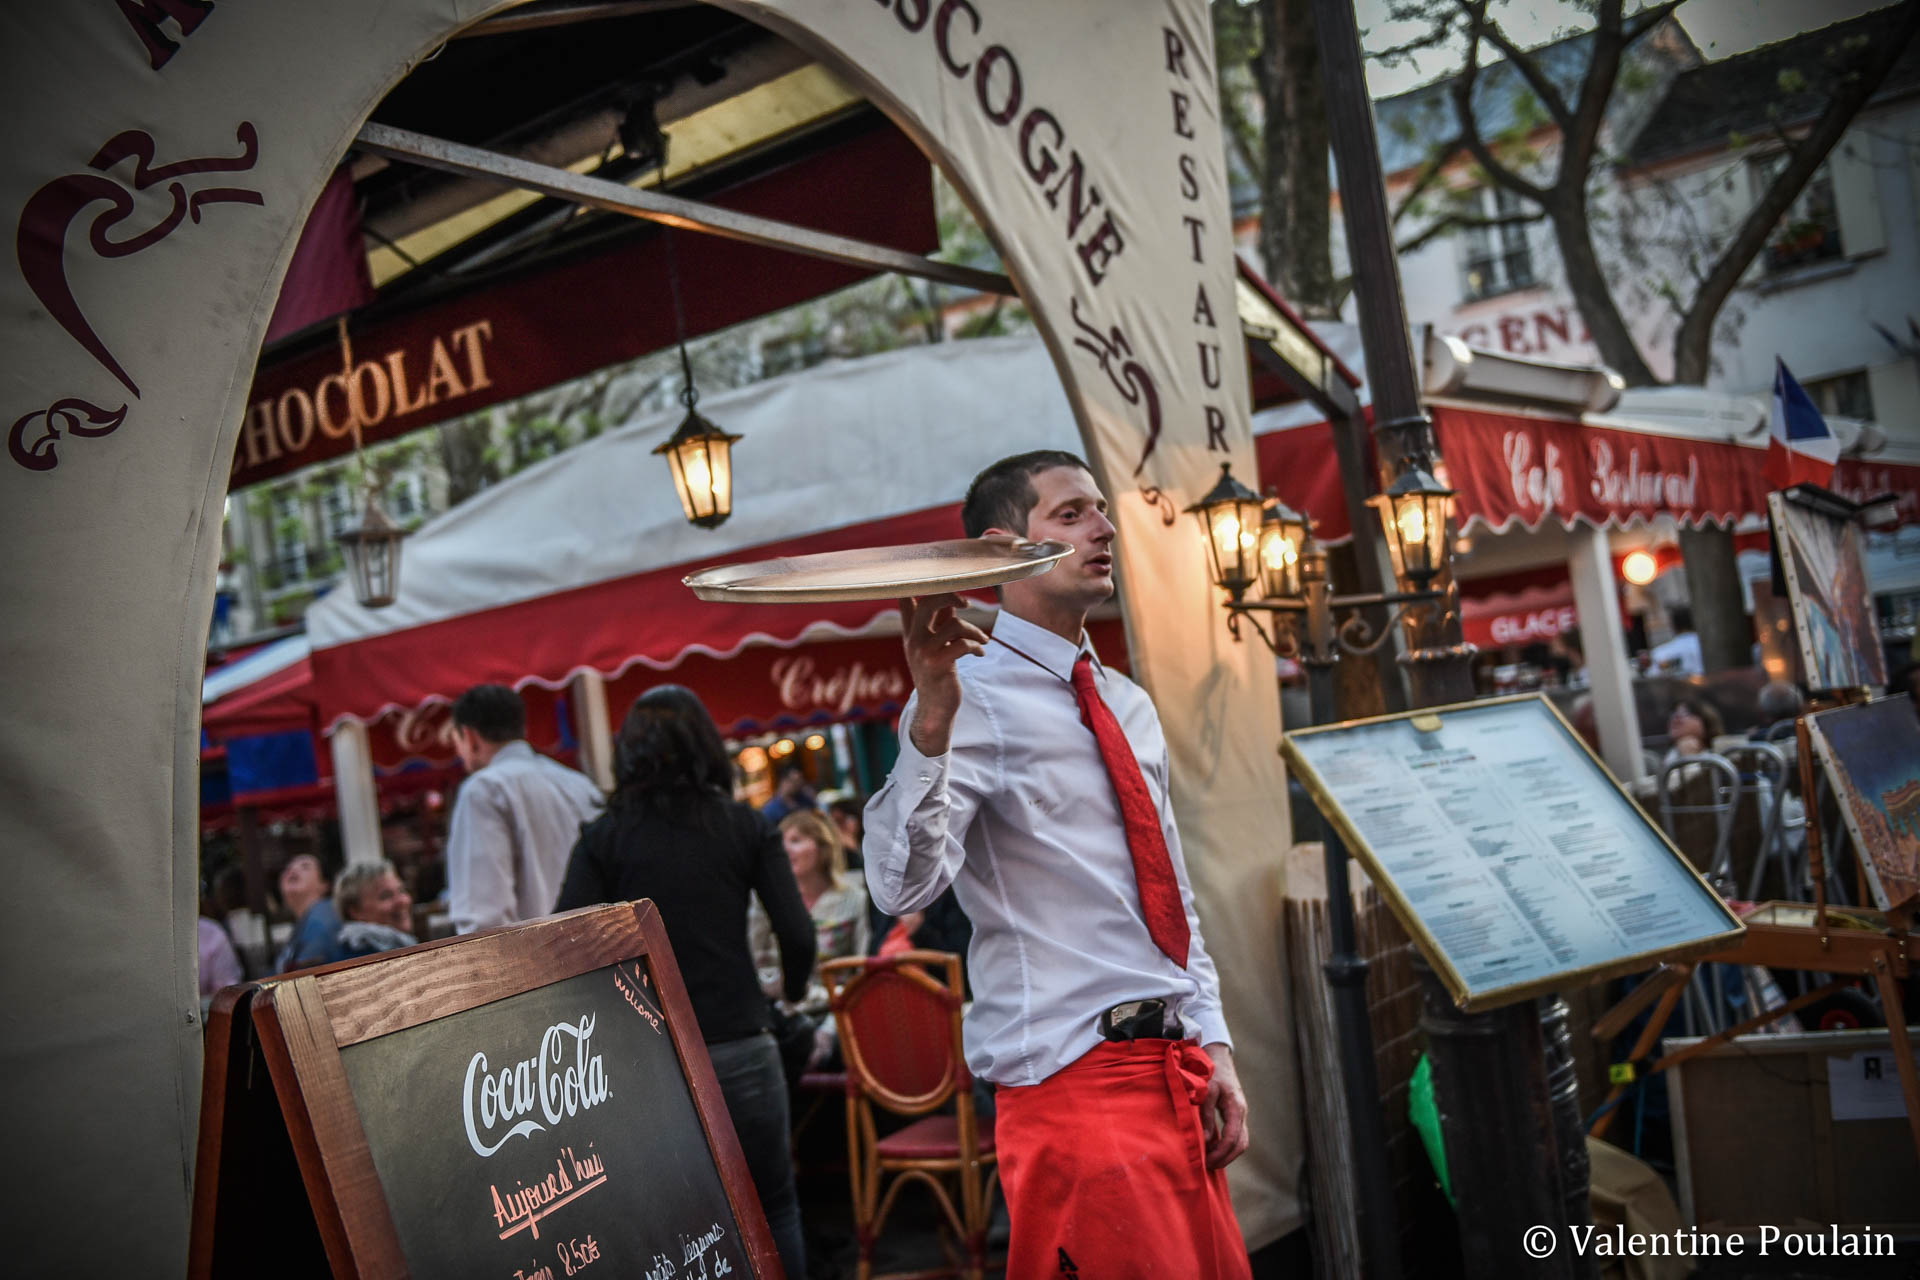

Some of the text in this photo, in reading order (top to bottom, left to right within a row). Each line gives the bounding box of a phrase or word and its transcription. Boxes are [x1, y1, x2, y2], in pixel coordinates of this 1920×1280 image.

[874, 0, 1125, 287] COGNE
[1163, 26, 1231, 454] RESTAUR
[233, 320, 493, 475] HOCOLAT
[463, 1010, 609, 1157] Coca-Cola
